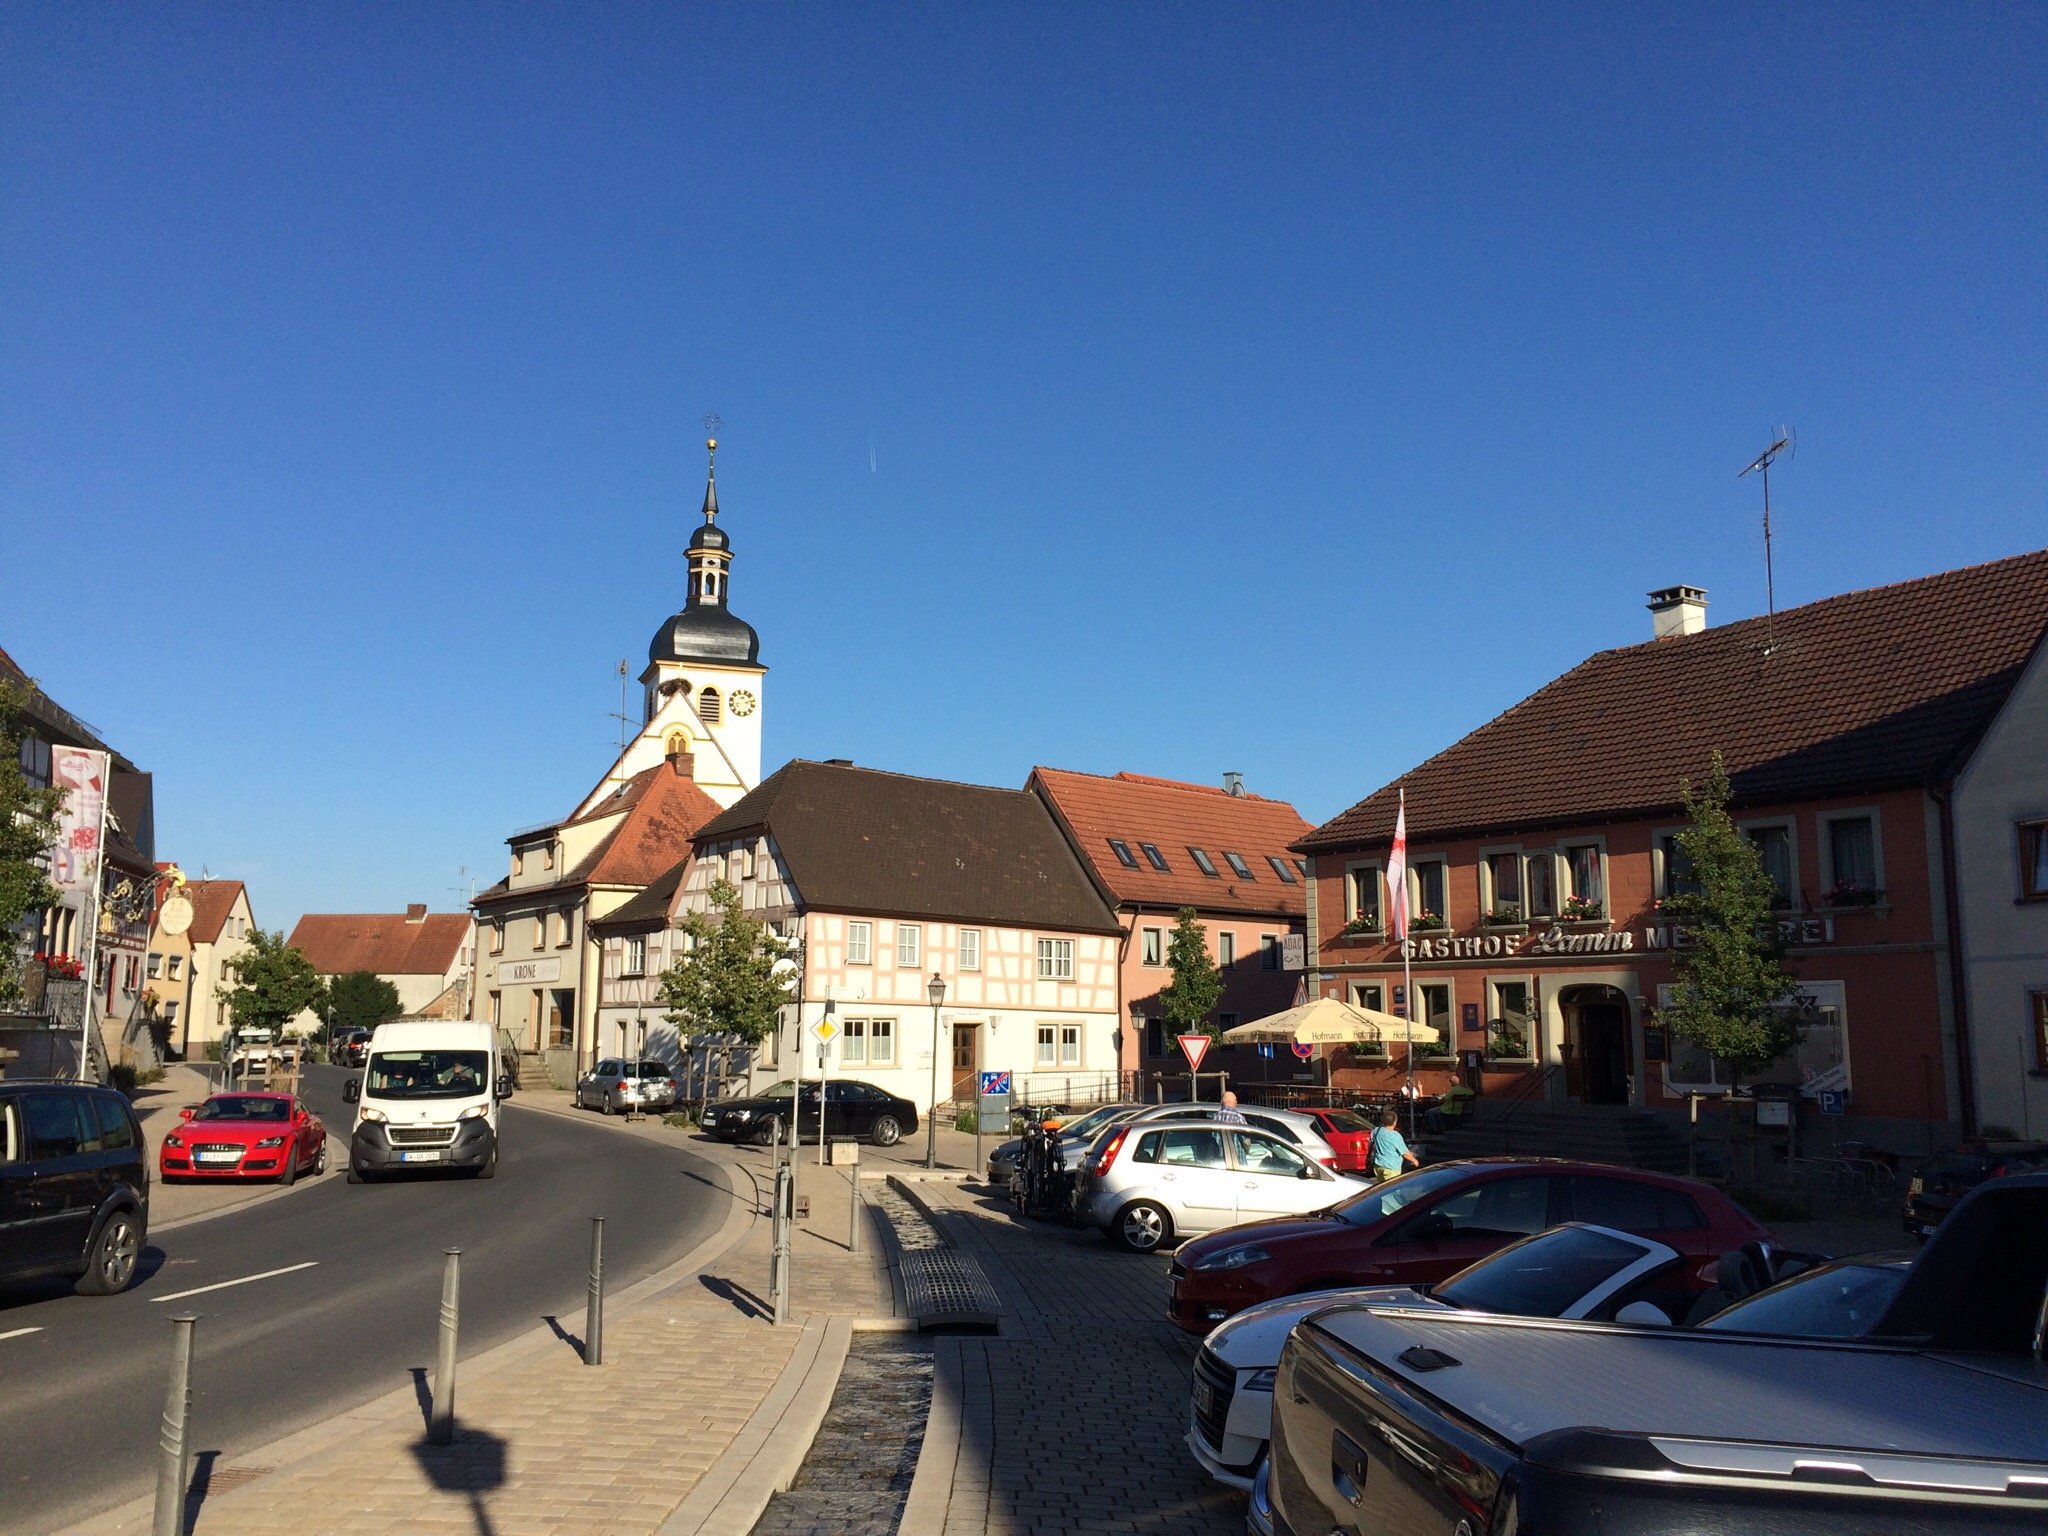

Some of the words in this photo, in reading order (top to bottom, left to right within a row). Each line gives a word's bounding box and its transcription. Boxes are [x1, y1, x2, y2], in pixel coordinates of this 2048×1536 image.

[1284, 937, 1302, 950] ADAC
[1401, 935, 1520, 959] GASTHOF
[1531, 926, 1634, 954] Lamm
[514, 964, 537, 980] KRONE
[1312, 1031, 1343, 1041] Hofmann
[1823, 1093, 1835, 1111] P
